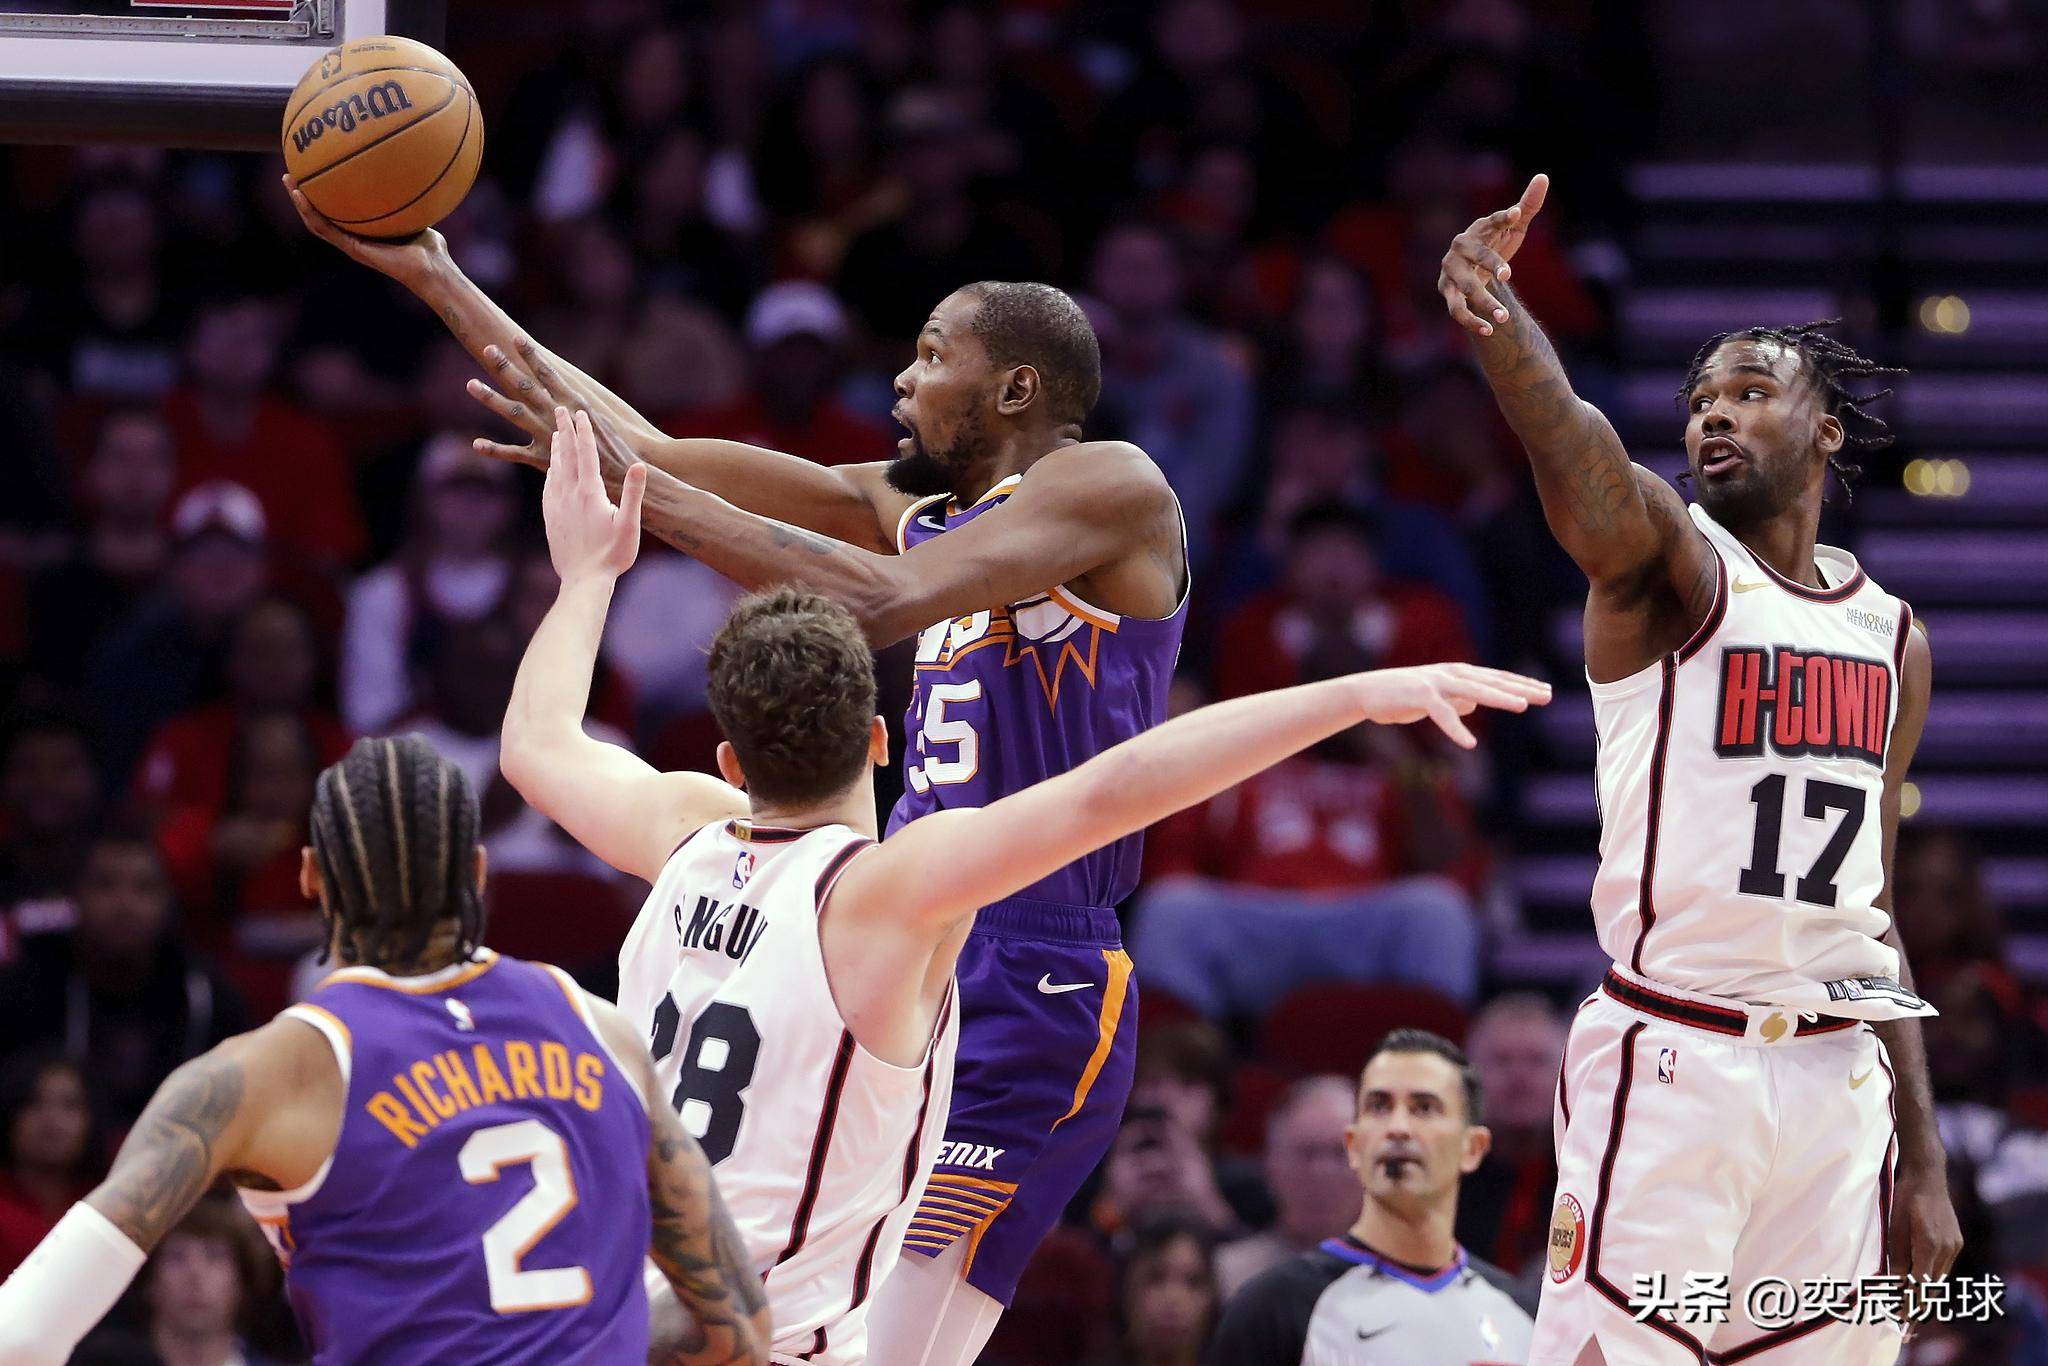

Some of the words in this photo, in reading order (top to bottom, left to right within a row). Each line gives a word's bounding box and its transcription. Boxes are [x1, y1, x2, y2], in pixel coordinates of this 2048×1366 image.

[292, 80, 412, 154] Wilson
[1846, 613, 1892, 637] HERMANN
[1847, 607, 1893, 631] MEMORIAL
[1738, 774, 1869, 908] 17
[366, 1040, 605, 1149] RICHARDS
[457, 1119, 594, 1315] 2
